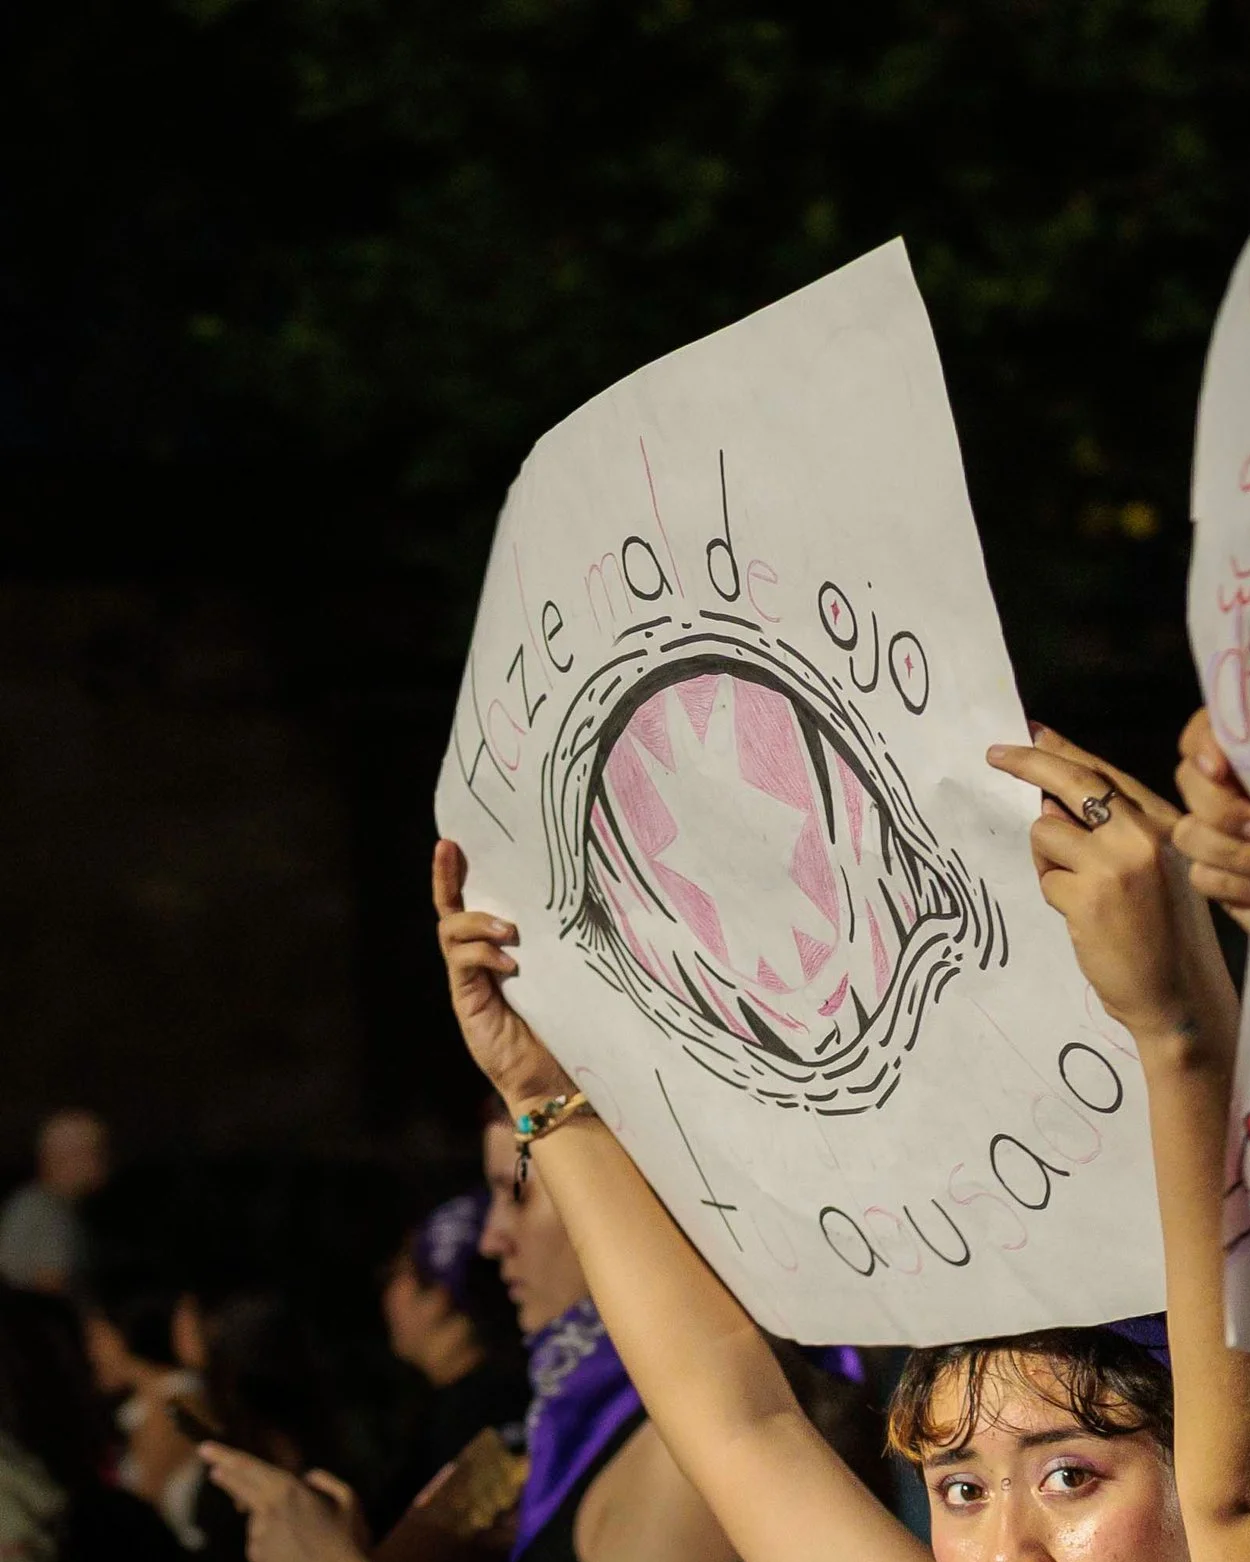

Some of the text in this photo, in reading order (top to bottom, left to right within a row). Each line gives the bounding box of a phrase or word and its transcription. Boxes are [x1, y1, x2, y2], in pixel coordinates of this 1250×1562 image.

[453, 436, 931, 842] Hazle mal de ojo
